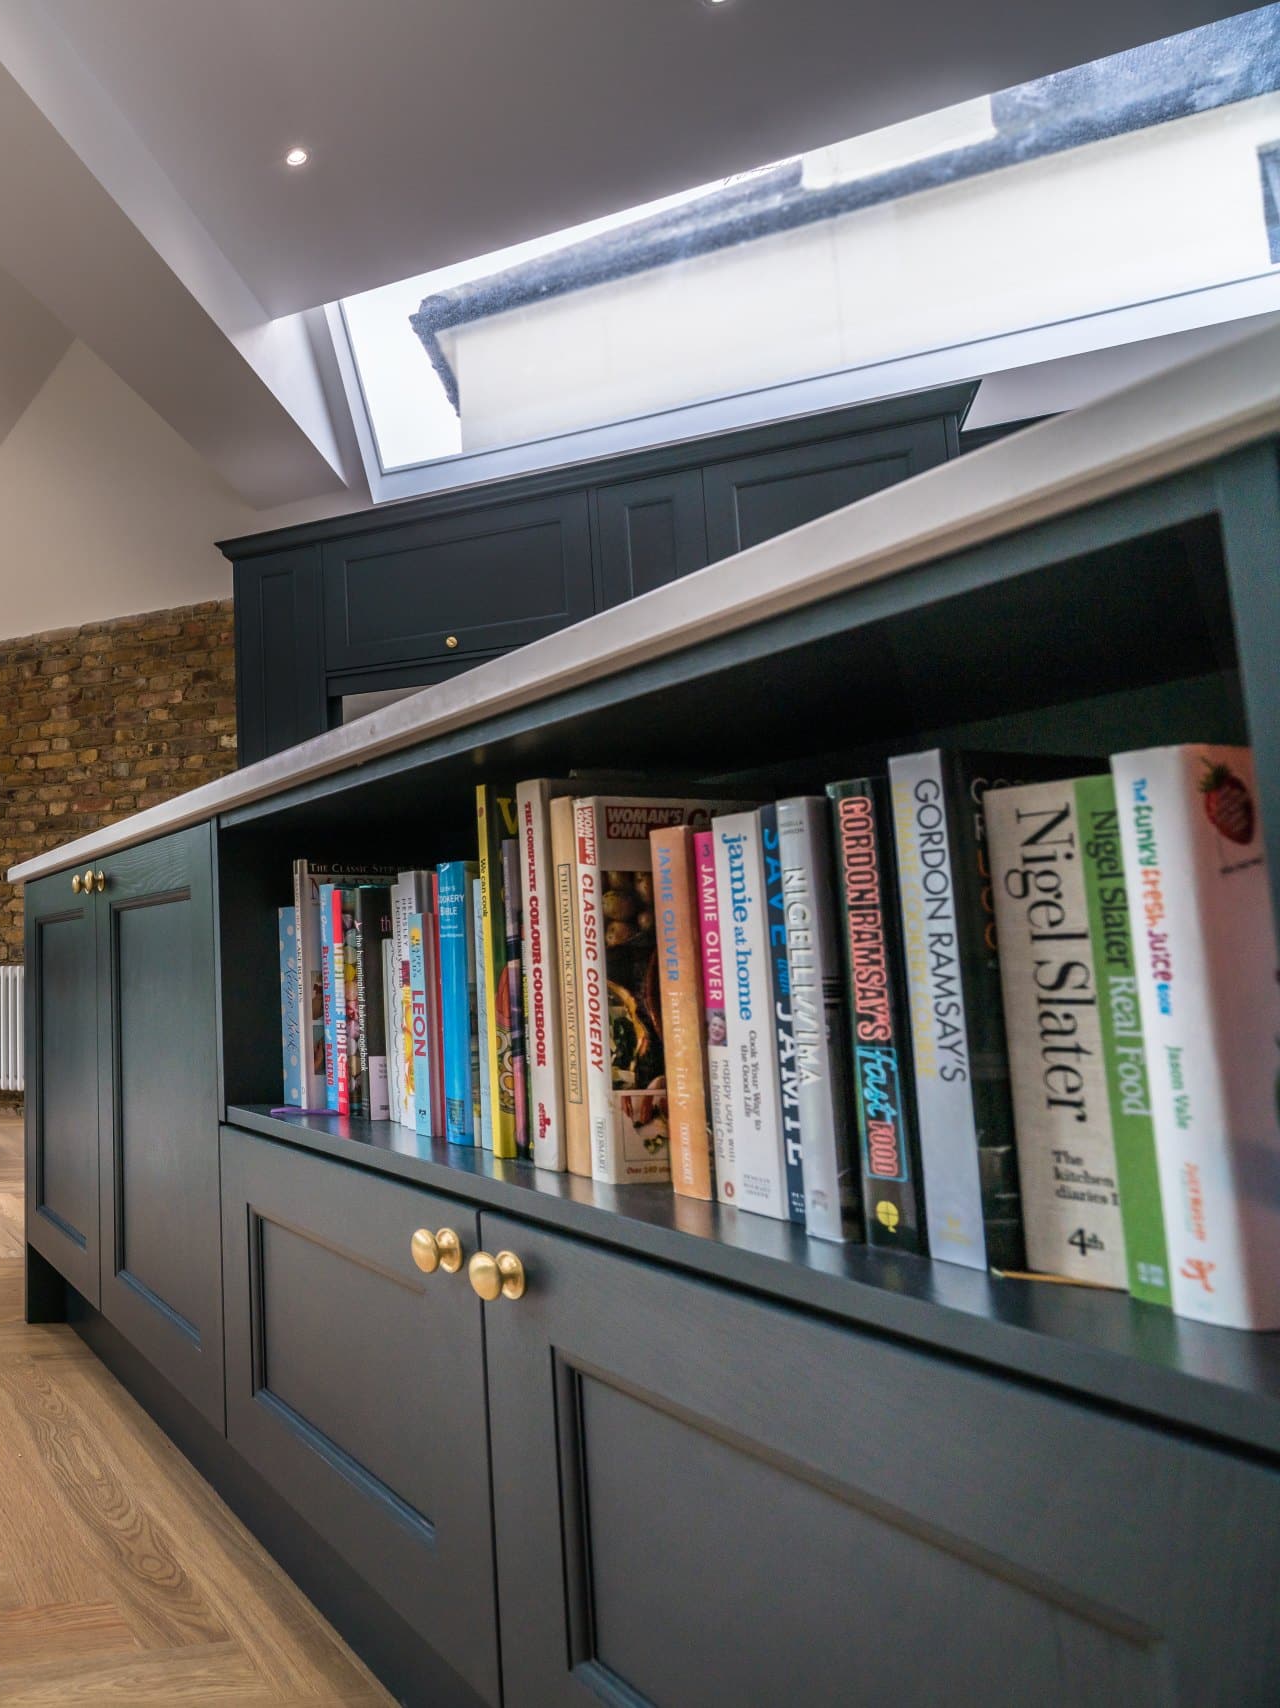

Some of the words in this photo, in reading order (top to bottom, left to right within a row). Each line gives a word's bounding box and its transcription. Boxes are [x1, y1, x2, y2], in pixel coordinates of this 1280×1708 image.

[524, 801, 532, 826] THE
[576, 808, 586, 837] OWN
[584, 806, 596, 865] WOMAN'S
[607, 807, 682, 824] WOMAN'S
[609, 823, 646, 838] OWN
[893, 782, 918, 876] ULTIMATE
[1133, 804, 1158, 867] funky
[480, 858, 486, 873] We
[526, 828, 537, 892] COMPLETE
[658, 847, 673, 900] JAMIE
[839, 796, 881, 907] GORDON
[914, 778, 952, 921] GORDON
[1004, 801, 1089, 943] Nigel
[1086, 810, 1125, 880] Nigel
[561, 871, 569, 894] THE
[701, 864, 717, 922] JAMIE
[721, 832, 752, 923] jamie
[1140, 868, 1165, 928] fresh
[529, 895, 542, 964] COLOUR
[562, 897, 570, 934] DAIRY
[582, 873, 598, 961] CLASSIC
[662, 909, 680, 981] OLIVER
[733, 926, 745, 945] at
[901, 881, 928, 985] COOKERY
[1098, 885, 1130, 969] Slater
[563, 937, 572, 969] BOOK
[566, 973, 574, 987] OF
[705, 931, 723, 1000] OLIVER
[783, 866, 823, 1087] NIGELLISSIMA
[848, 909, 892, 1041] RAMSAY'S
[567, 990, 576, 1031] FAMILY
[735, 947, 753, 1021] home
[764, 828, 786, 946] SAVE
[775, 1002, 803, 1166] JAMIE
[928, 932, 967, 1083] RAMSAY'S
[1108, 974, 1144, 1038] Real
[322, 946, 330, 990] British
[326, 1043, 334, 1086] BAKING
[412, 990, 426, 1057] LEON
[532, 967, 546, 1067] COOKBOOK
[587, 966, 604, 1073] COOKERY
[749, 1030, 758, 1059] Cook
[911, 990, 938, 1081] COURSE
[1032, 959, 1096, 1123] Slater
[568, 1034, 580, 1100] COOKERY
[711, 1061, 719, 1082] the
[741, 1044, 749, 1064] the
[741, 1065, 751, 1097] Good
[751, 1061, 761, 1091] Your
[1115, 1045, 1153, 1116] Food
[1165, 1045, 1184, 1091] Jason
[745, 1098, 754, 1118] Life
[752, 1092, 762, 1119] Way
[857, 1049, 897, 1124] fast
[1172, 1094, 1193, 1130] Vale
[754, 1121, 763, 1131] to
[868, 1120, 899, 1177] FOOD
[1053, 1150, 1084, 1167] The
[1053, 1166, 1114, 1189] kitchen
[1054, 1186, 1108, 1206] diaries
[1068, 1228, 1105, 1256] 4th
